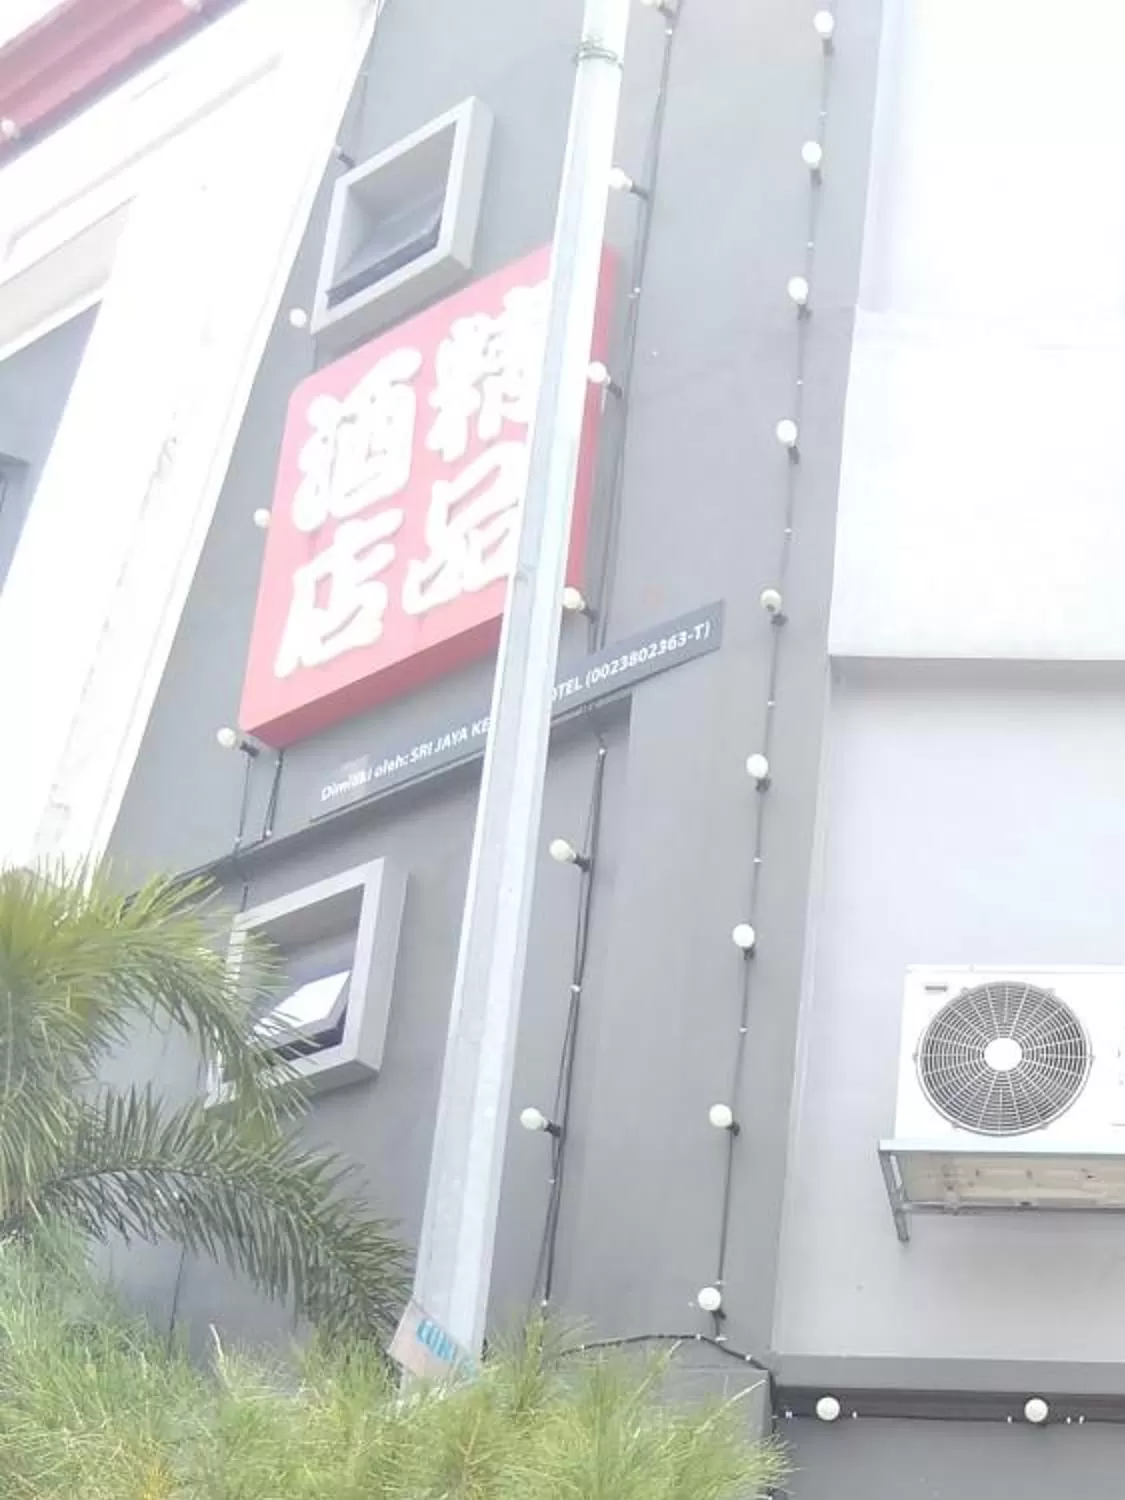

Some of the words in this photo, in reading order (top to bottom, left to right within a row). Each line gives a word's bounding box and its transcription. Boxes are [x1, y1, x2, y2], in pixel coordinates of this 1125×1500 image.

[410, 741, 433, 763] SRI
[434, 726, 468, 753] JAYA
[551, 676, 584, 702] OTEL
